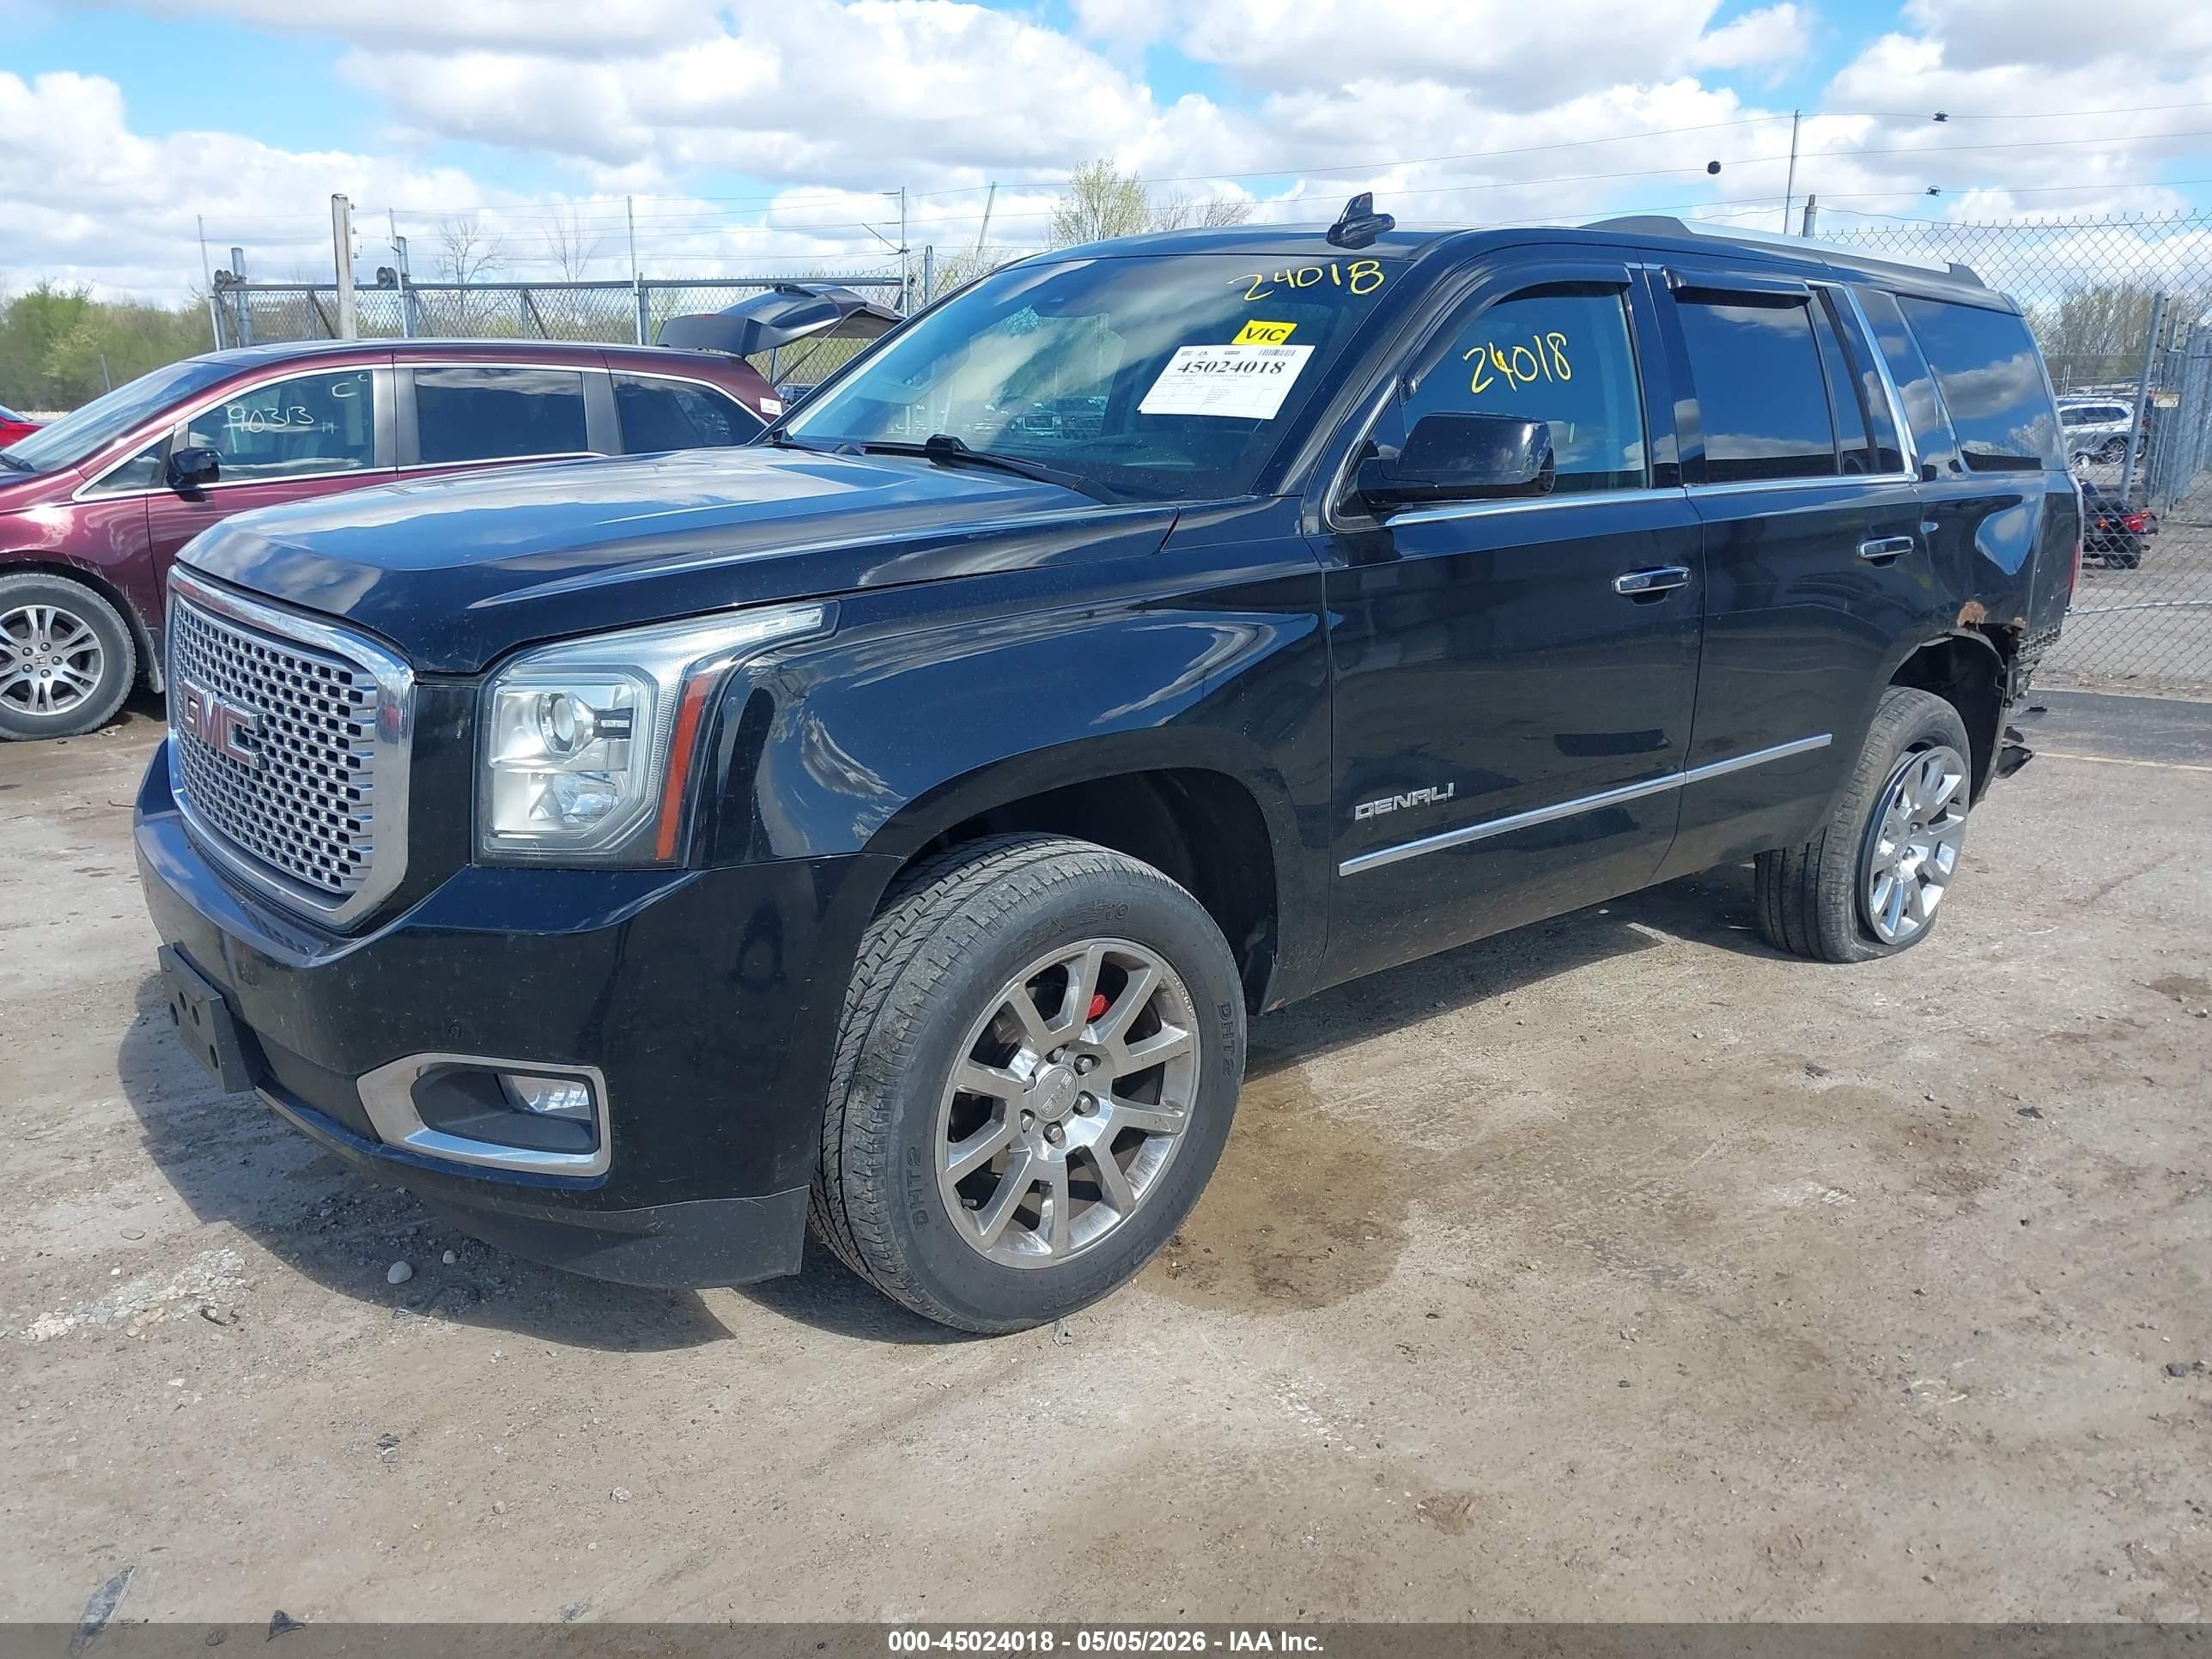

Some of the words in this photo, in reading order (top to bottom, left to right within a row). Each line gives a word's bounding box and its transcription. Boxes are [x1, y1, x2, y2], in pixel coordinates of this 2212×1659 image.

[1245, 327, 1286, 342] VIC
[1177, 361, 1286, 374] 45024018
[1462, 332, 1571, 393] 24018
[228, 405, 315, 434] 90313
[181, 679, 261, 769] GMC
[1354, 782, 1455, 821] DENALI
[1218, 1002, 1235, 1076] DHT2
[907, 1146, 929, 1230] DHT2
